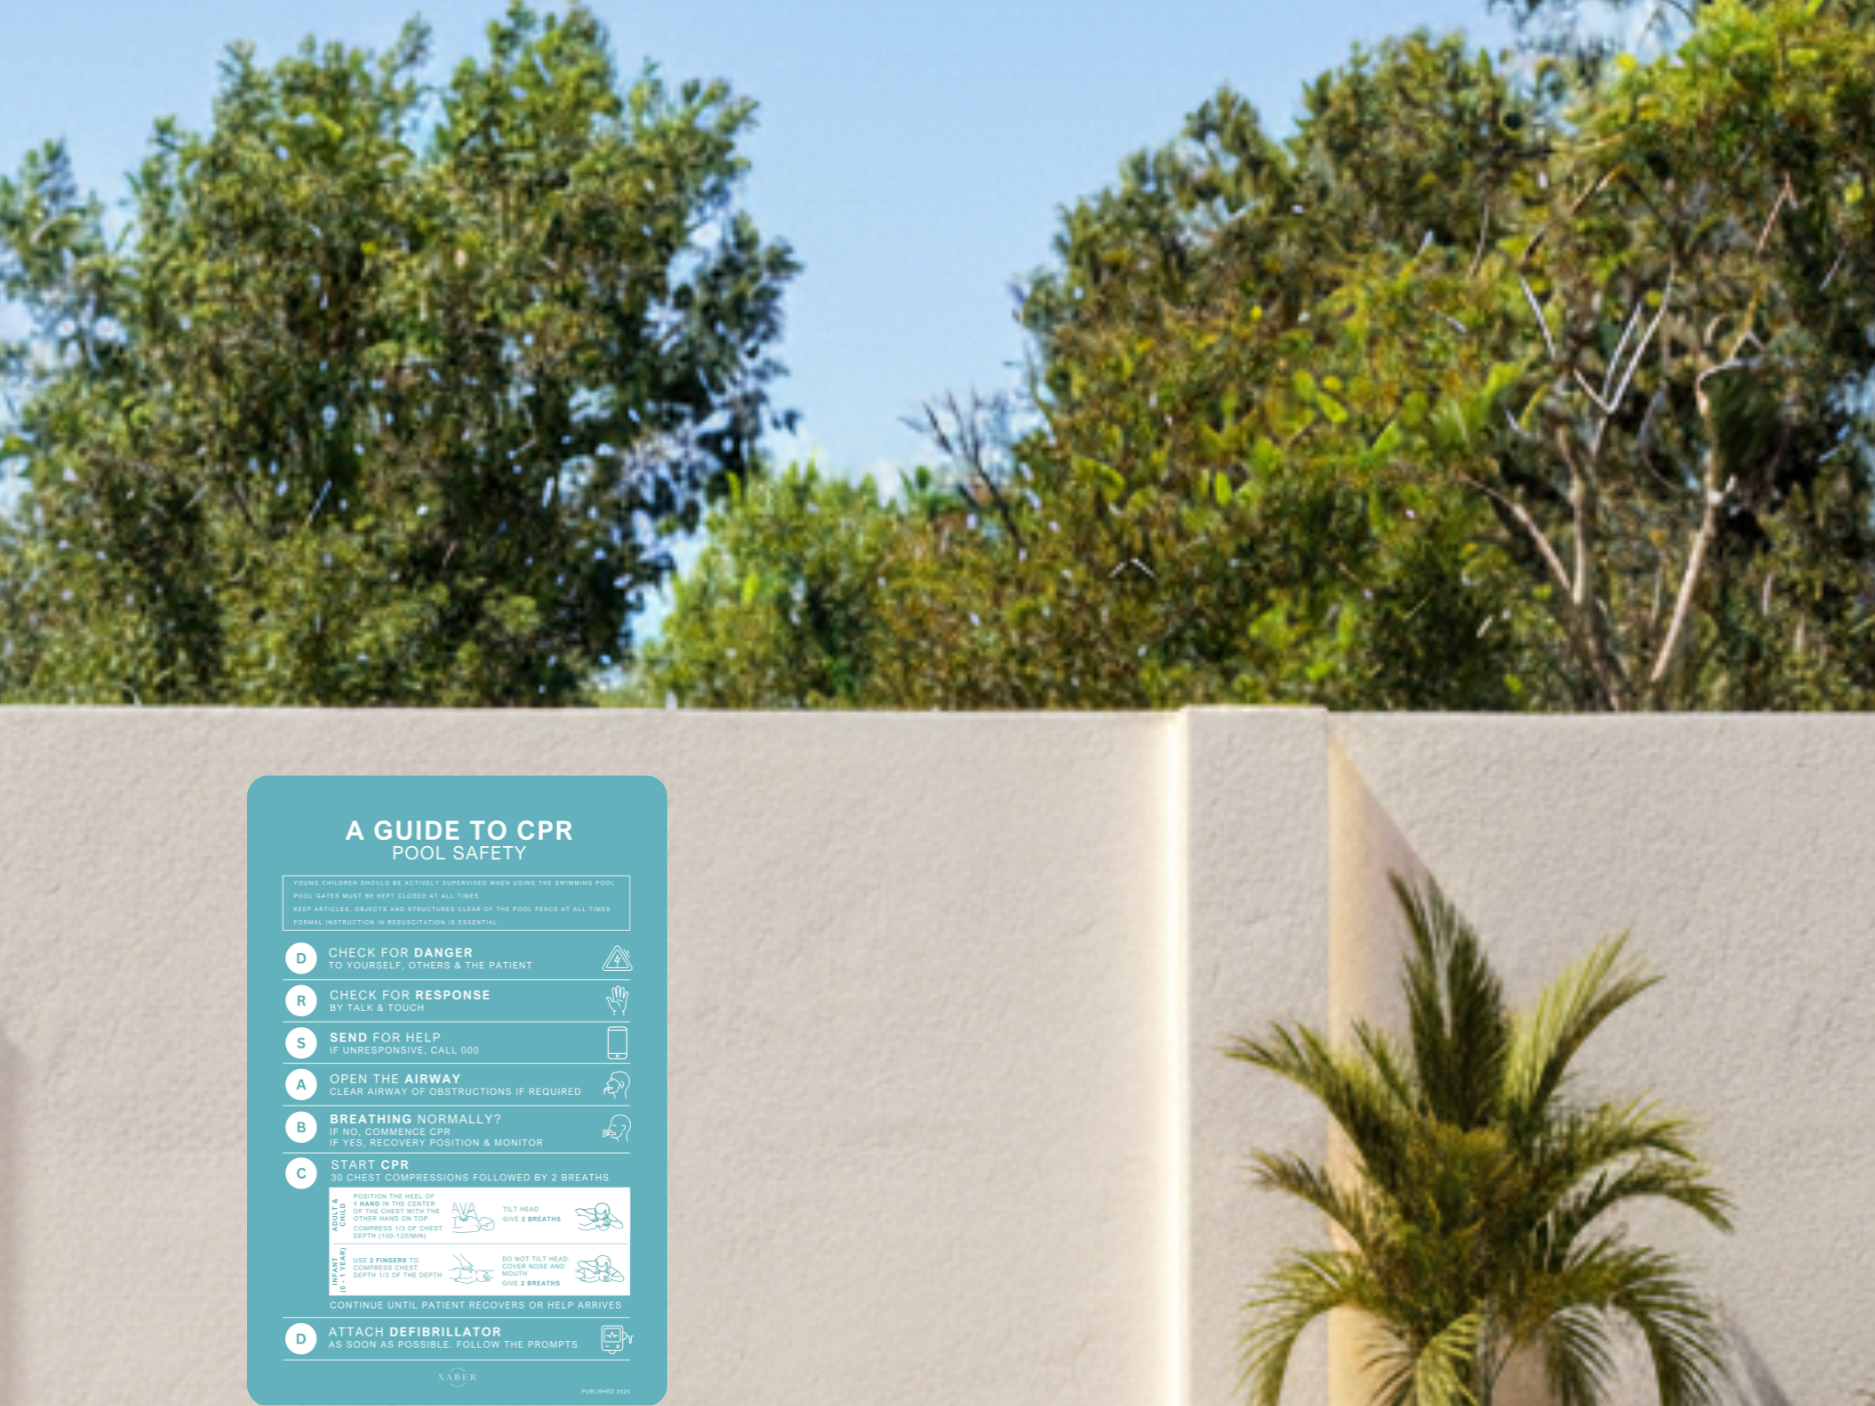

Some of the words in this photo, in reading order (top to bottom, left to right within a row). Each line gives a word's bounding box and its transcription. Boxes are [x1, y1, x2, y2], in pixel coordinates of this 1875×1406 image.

[345, 820, 365, 841] A
[374, 820, 460, 841] GUIDE
[469, 820, 507, 841] TO
[517, 820, 573, 841] CPR
[393, 845, 446, 861] POOL
[453, 845, 527, 861] SAFETY
[296, 952, 307, 964] D
[328, 947, 376, 958] CHECK
[381, 947, 408, 958] FOR
[414, 947, 473, 958] DANGER
[328, 961, 343, 970] TO
[346, 961, 404, 970] YOURSELF,
[408, 961, 451, 970] OTHERS
[454, 961, 461, 970] &
[464, 961, 485, 970] THE
[489, 961, 533, 970] PATIENT
[329, 989, 377, 1000] CHECK
[382, 989, 410, 1000] FOR
[415, 989, 490, 1000] RESPONSE
[297, 995, 306, 1007] R
[329, 1003, 343, 1012] BY
[347, 1003, 373, 1012] TALK
[376, 1003, 384, 1012] &
[387, 1003, 424, 1012] TOUCH
[297, 1037, 306, 1049] S
[330, 1032, 367, 1043] SEND
[373, 1032, 400, 1043] FOR
[406, 1032, 441, 1043] HELP
[329, 1046, 339, 1054] IF
[342, 1046, 427, 1055] UNRESPONSIVE,
[430, 1046, 457, 1055] CALL
[460, 1046, 479, 1055] 000
[329, 1073, 367, 1084] OPEN
[372, 1073, 399, 1084] THE
[404, 1073, 461, 1084] AIRWAY
[296, 1079, 307, 1090] A
[329, 1087, 364, 1096] CLEAR
[367, 1087, 408, 1096] AIRWAY
[411, 1087, 425, 1096] OF
[429, 1087, 512, 1096] OBSTRUCTIONS
[515, 1087, 525, 1096] IF
[528, 1087, 582, 1096] REQUIRED
[330, 1113, 412, 1124] BREATHING
[417, 1113, 501, 1124] NORMALLY?
[297, 1121, 306, 1133] B
[329, 1127, 339, 1136] IF
[342, 1127, 361, 1137] NO,
[364, 1127, 426, 1136] COMMENCE
[429, 1127, 451, 1136] CPR
[329, 1138, 339, 1147] IF
[342, 1138, 366, 1147] YES,
[369, 1138, 426, 1147] RECOVERY
[429, 1138, 480, 1147] POSITION
[483, 1138, 491, 1147] &
[494, 1138, 543, 1147] MONITOR
[331, 1159, 375, 1170] START
[380, 1159, 409, 1170] CPR
[296, 1167, 307, 1179] C
[330, 1173, 343, 1182] 30
[346, 1173, 381, 1182] CHEST
[384, 1173, 469, 1182] COMPRESSIONS
[473, 1173, 531, 1182] FOLLOWED
[534, 1173, 548, 1182] BY
[551, 1173, 557, 1182] 2
[561, 1173, 609, 1182] BREATHS
[329, 1301, 383, 1310] CONTINUE
[387, 1301, 418, 1310] UNTIL
[421, 1301, 465, 1310] PATIENT
[469, 1301, 525, 1310] RECOVERS
[528, 1301, 544, 1310] OR
[547, 1301, 574, 1310] HELP
[577, 1301, 622, 1310] ARRIVES
[328, 1326, 384, 1337] ATTACH
[389, 1326, 501, 1337] DEFIBRILLATOR
[296, 1333, 307, 1345] D
[328, 1340, 342, 1349] AS
[346, 1340, 377, 1349] SOON
[380, 1340, 394, 1349] AS
[398, 1340, 452, 1349] POSSIBLE.
[456, 1340, 501, 1349] FOLLOW
[503, 1340, 524, 1349] THE
[528, 1340, 578, 1349] PROMPTS
[438, 1373, 477, 1381] XABER
